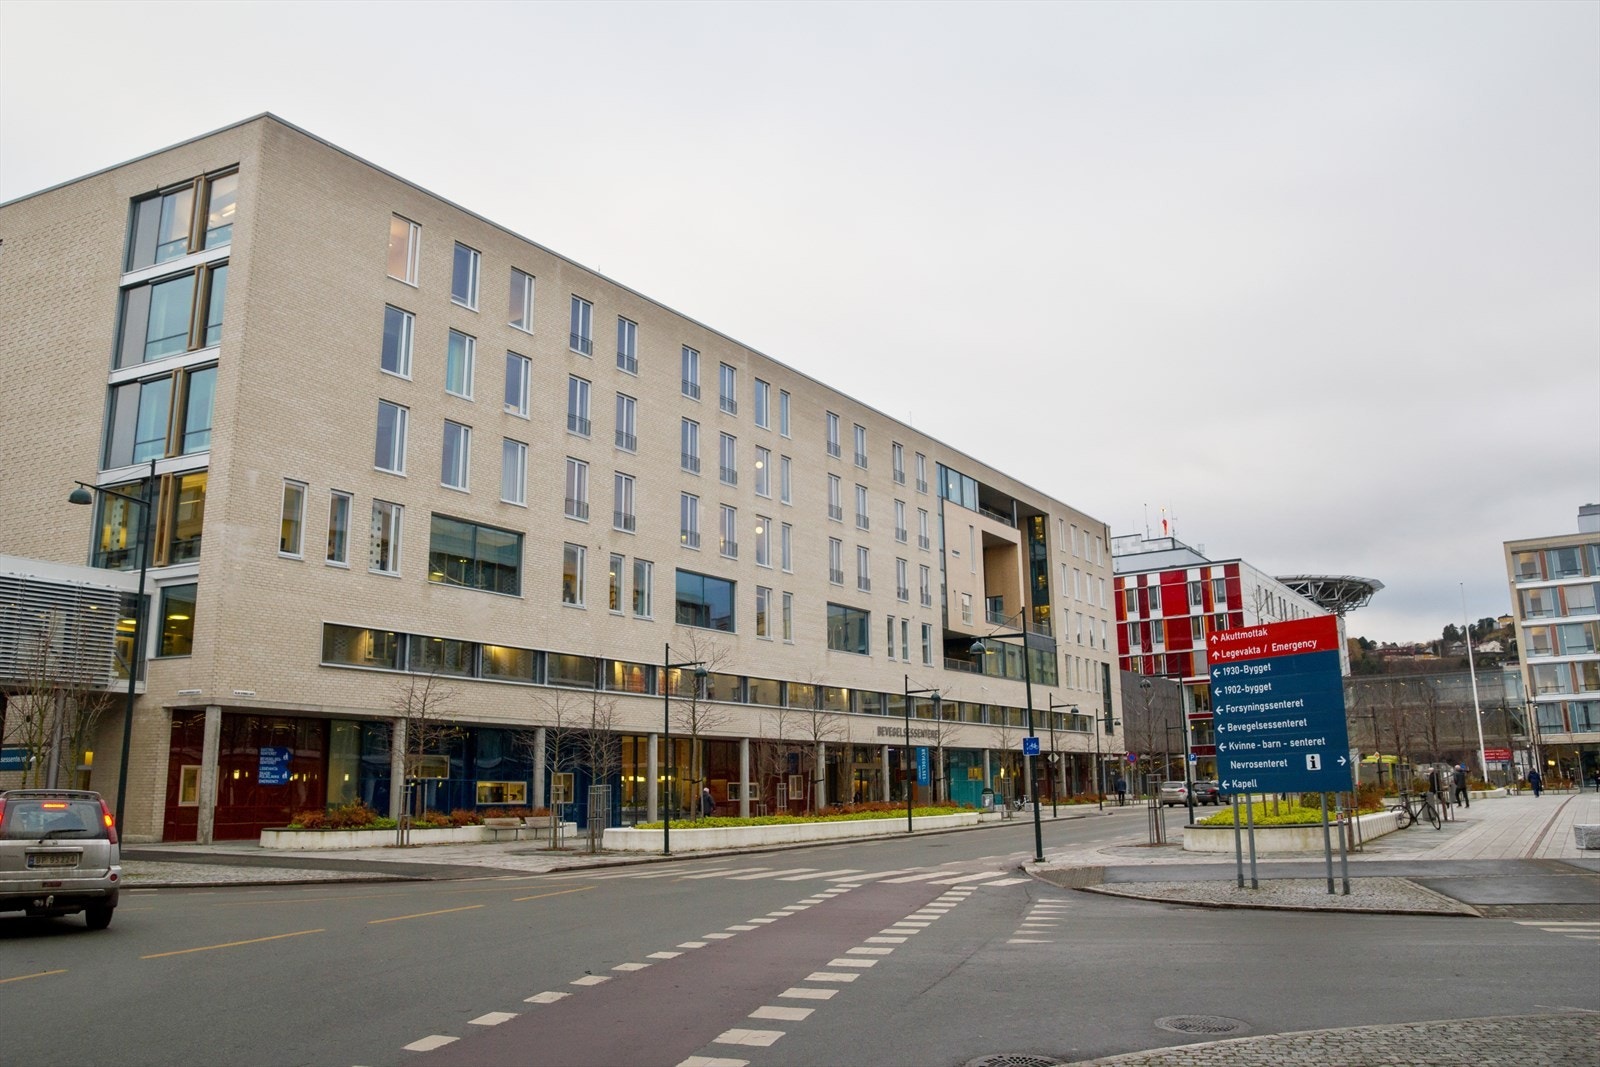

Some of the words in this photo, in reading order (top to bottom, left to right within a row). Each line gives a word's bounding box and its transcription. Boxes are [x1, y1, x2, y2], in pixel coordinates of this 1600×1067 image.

[1220, 628, 1268, 642] Akuttmottak
[1221, 646, 1261, 659] Legevakta
[1263, 644, 1268, 653] /
[1271, 640, 1317, 652] Emergency
[1223, 663, 1272, 676] 1930-Bygget
[1224, 682, 1272, 695] 1902-bygget
[1225, 698, 1304, 714] Forsyningssenteret
[1227, 718, 1307, 733] Bevegelsessenteret
[877, 726, 941, 739] BEVEGELSESSENTERE
[1228, 742, 1256, 751] Kvinne
[1262, 740, 1281, 749] barn
[1290, 737, 1326, 747] senteret
[1230, 759, 1288, 769] Nevrosenteret
[1231, 779, 1258, 789] Kapell
